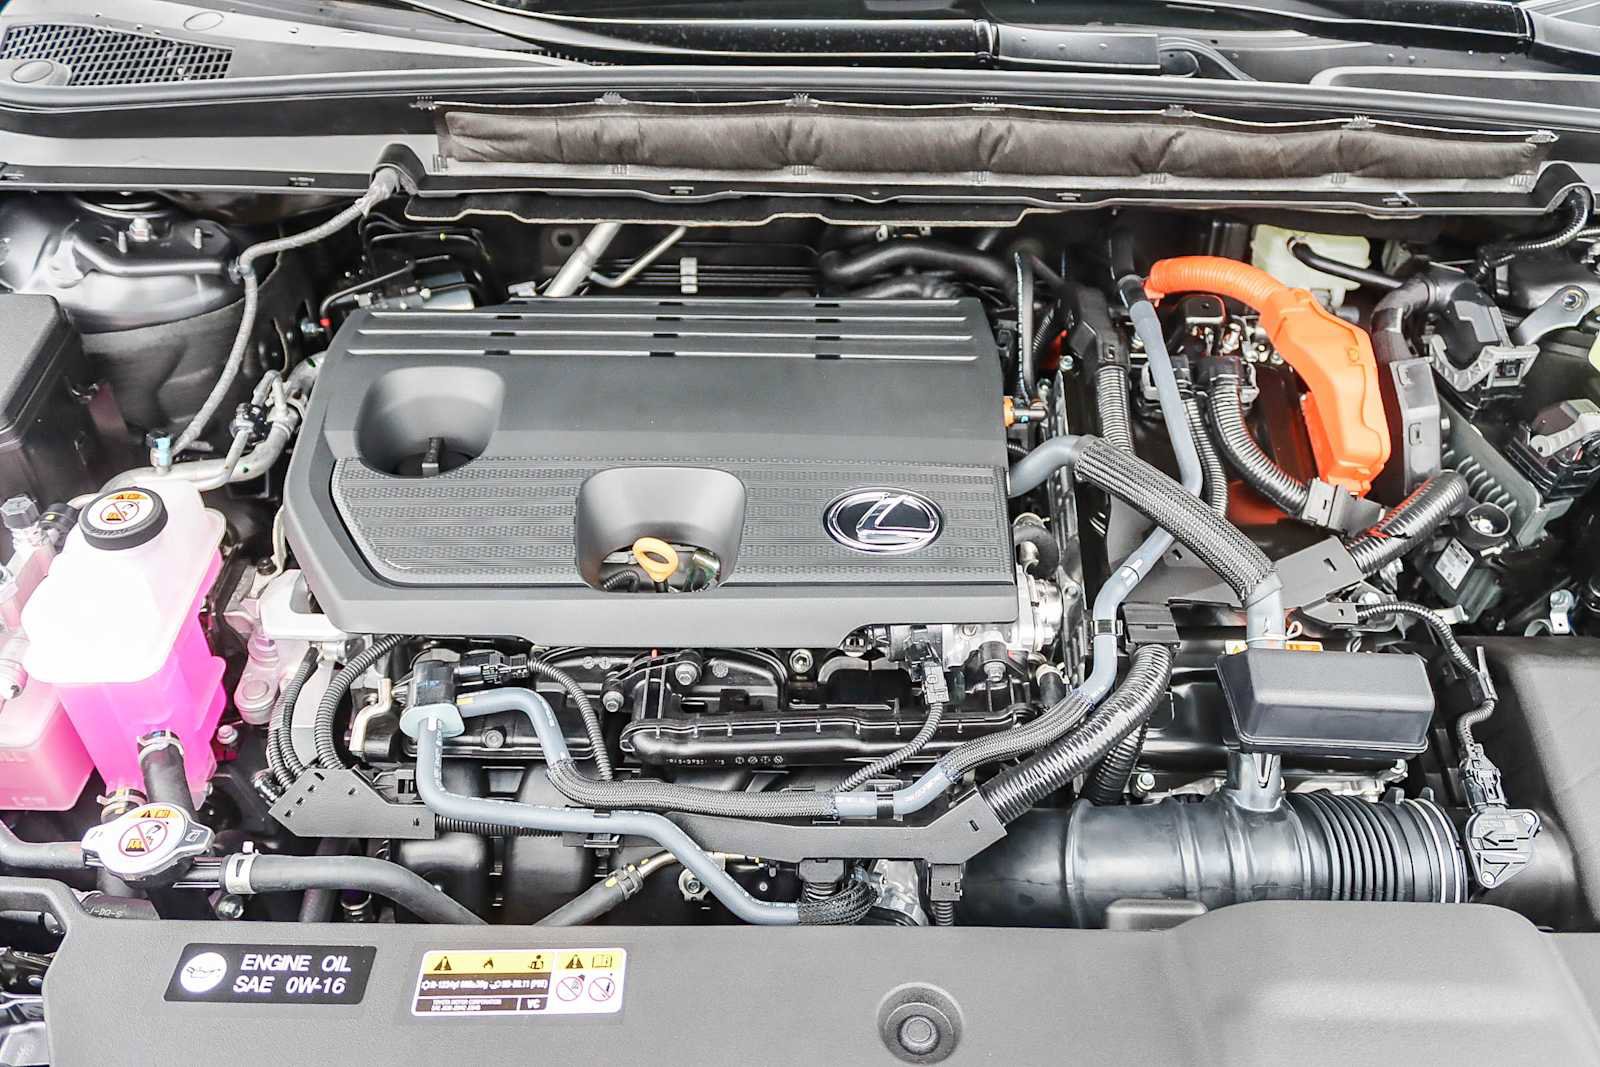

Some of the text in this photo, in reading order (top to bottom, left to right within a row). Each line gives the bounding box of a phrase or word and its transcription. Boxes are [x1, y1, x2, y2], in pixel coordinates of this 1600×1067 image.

[241, 954, 351, 972] ENGINE OIL
[233, 976, 345, 994] SAE 0W-16
